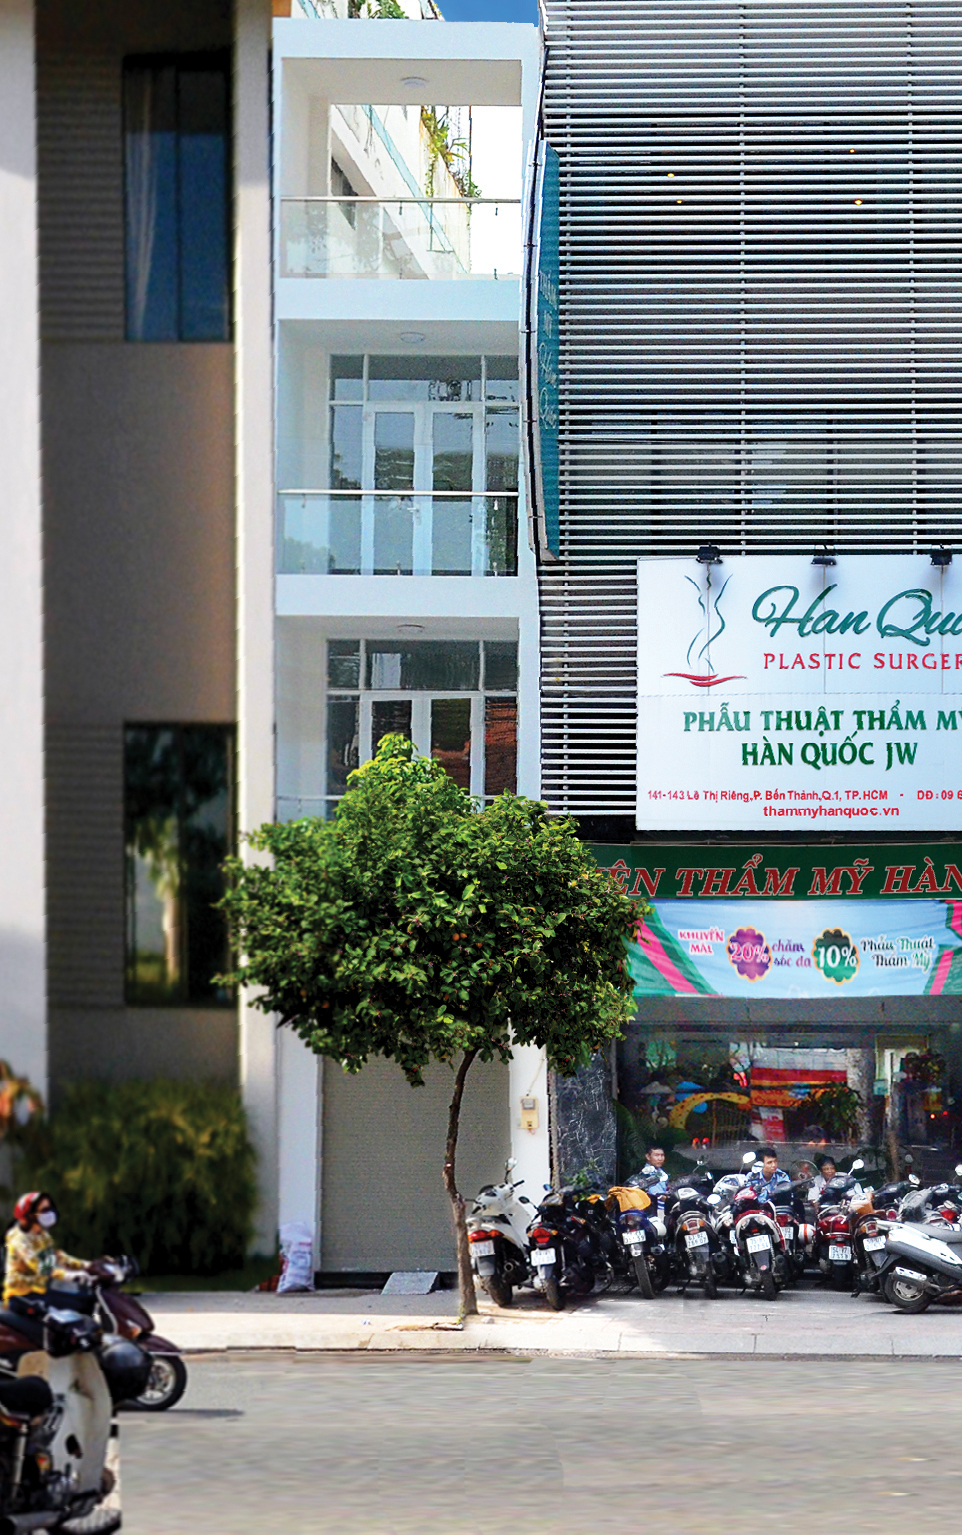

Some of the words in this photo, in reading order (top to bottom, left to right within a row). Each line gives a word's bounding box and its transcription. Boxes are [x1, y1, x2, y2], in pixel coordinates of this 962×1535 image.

[751, 583, 871, 638] Han
[763, 652, 862, 670] PLASTIC
[683, 701, 751, 732] PHẪU
[760, 705, 844, 737] THUẬT
[853, 699, 927, 731] THẨM
[741, 735, 793, 766] HÀN
[801, 730, 875, 771] QUỐC
[885, 742, 918, 771] JW
[648, 790, 685, 801] 141-143
[763, 805, 900, 819] thammyhanquoc.vn
[675, 853, 800, 897] THẨM
[807, 857, 874, 895] MỸ
[730, 942, 769, 963] 20%
[818, 944, 857, 968] 10%
